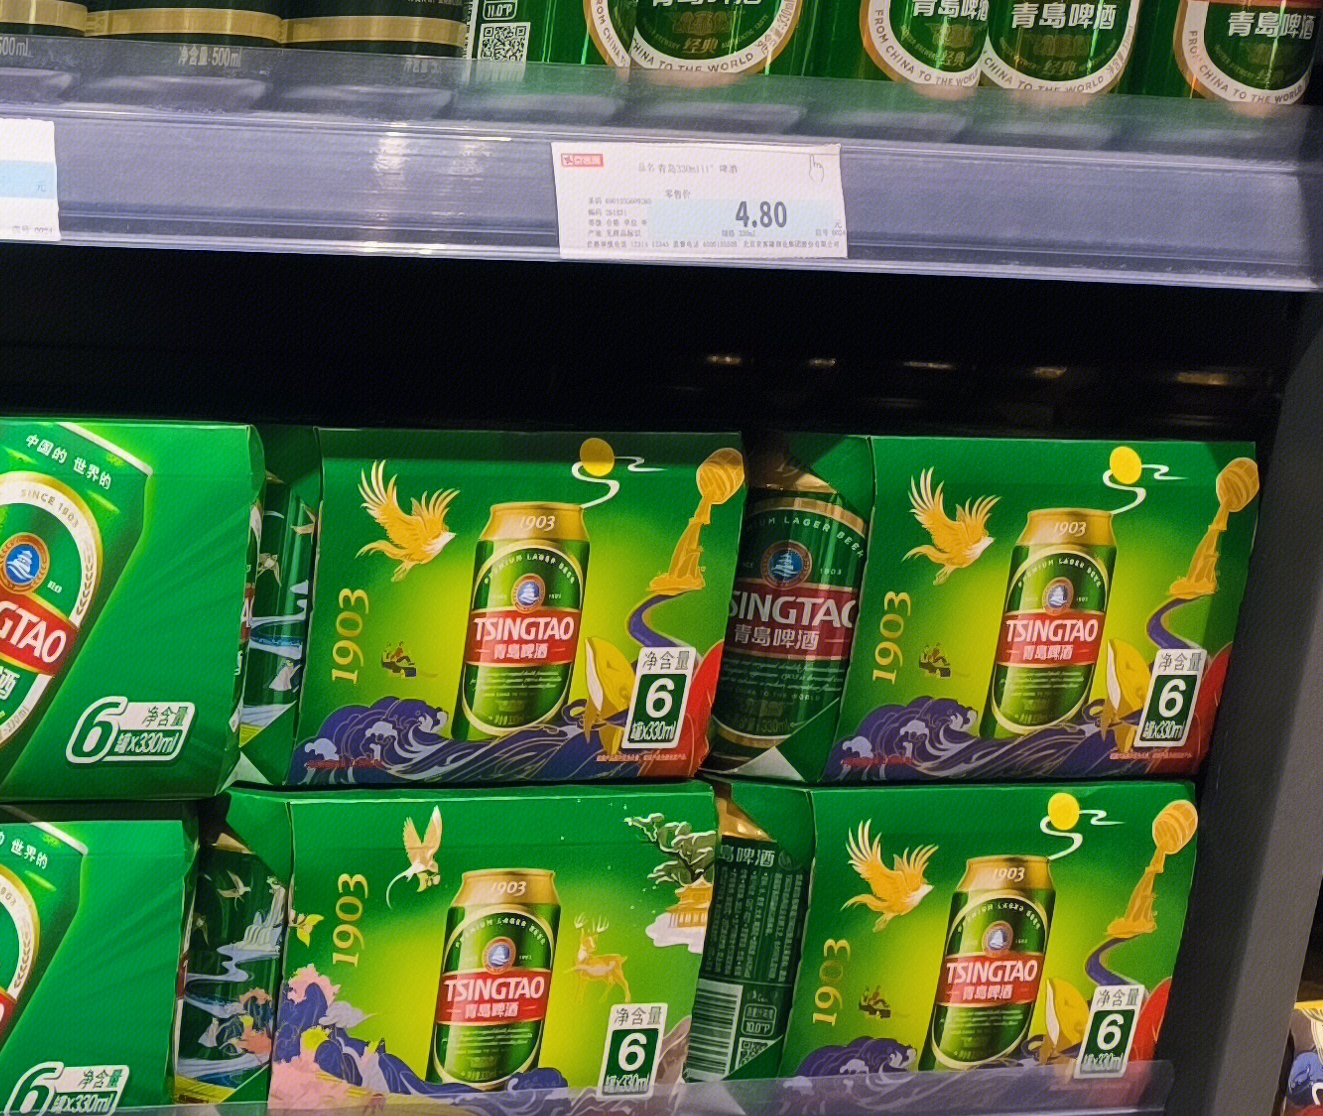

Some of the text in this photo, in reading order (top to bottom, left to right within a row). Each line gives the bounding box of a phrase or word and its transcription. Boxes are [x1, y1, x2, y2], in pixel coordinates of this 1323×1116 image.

[1011, 3, 1115, 30] 青島啤酒
[1228, 11, 1315, 40] 青島啤酒
[707, 52, 754, 72] WORLD
[736, 201, 787, 228] 4.80
[518, 515, 556, 531] 1903
[1053, 520, 1086, 537] 1903
[331, 588, 368, 684] 1903
[474, 617, 574, 641] TSINGTAO
[873, 591, 912, 685] 1903
[1006, 619, 1098, 643] TSINGTAO
[646, 678, 672, 718] 6
[67, 697, 128, 765] 6
[333, 874, 369, 967] 1903
[813, 938, 850, 1026] 1903
[946, 960, 1038, 984] TSINGTAO
[444, 976, 544, 1002] TSINGTAO
[618, 1033, 646, 1071] 6
